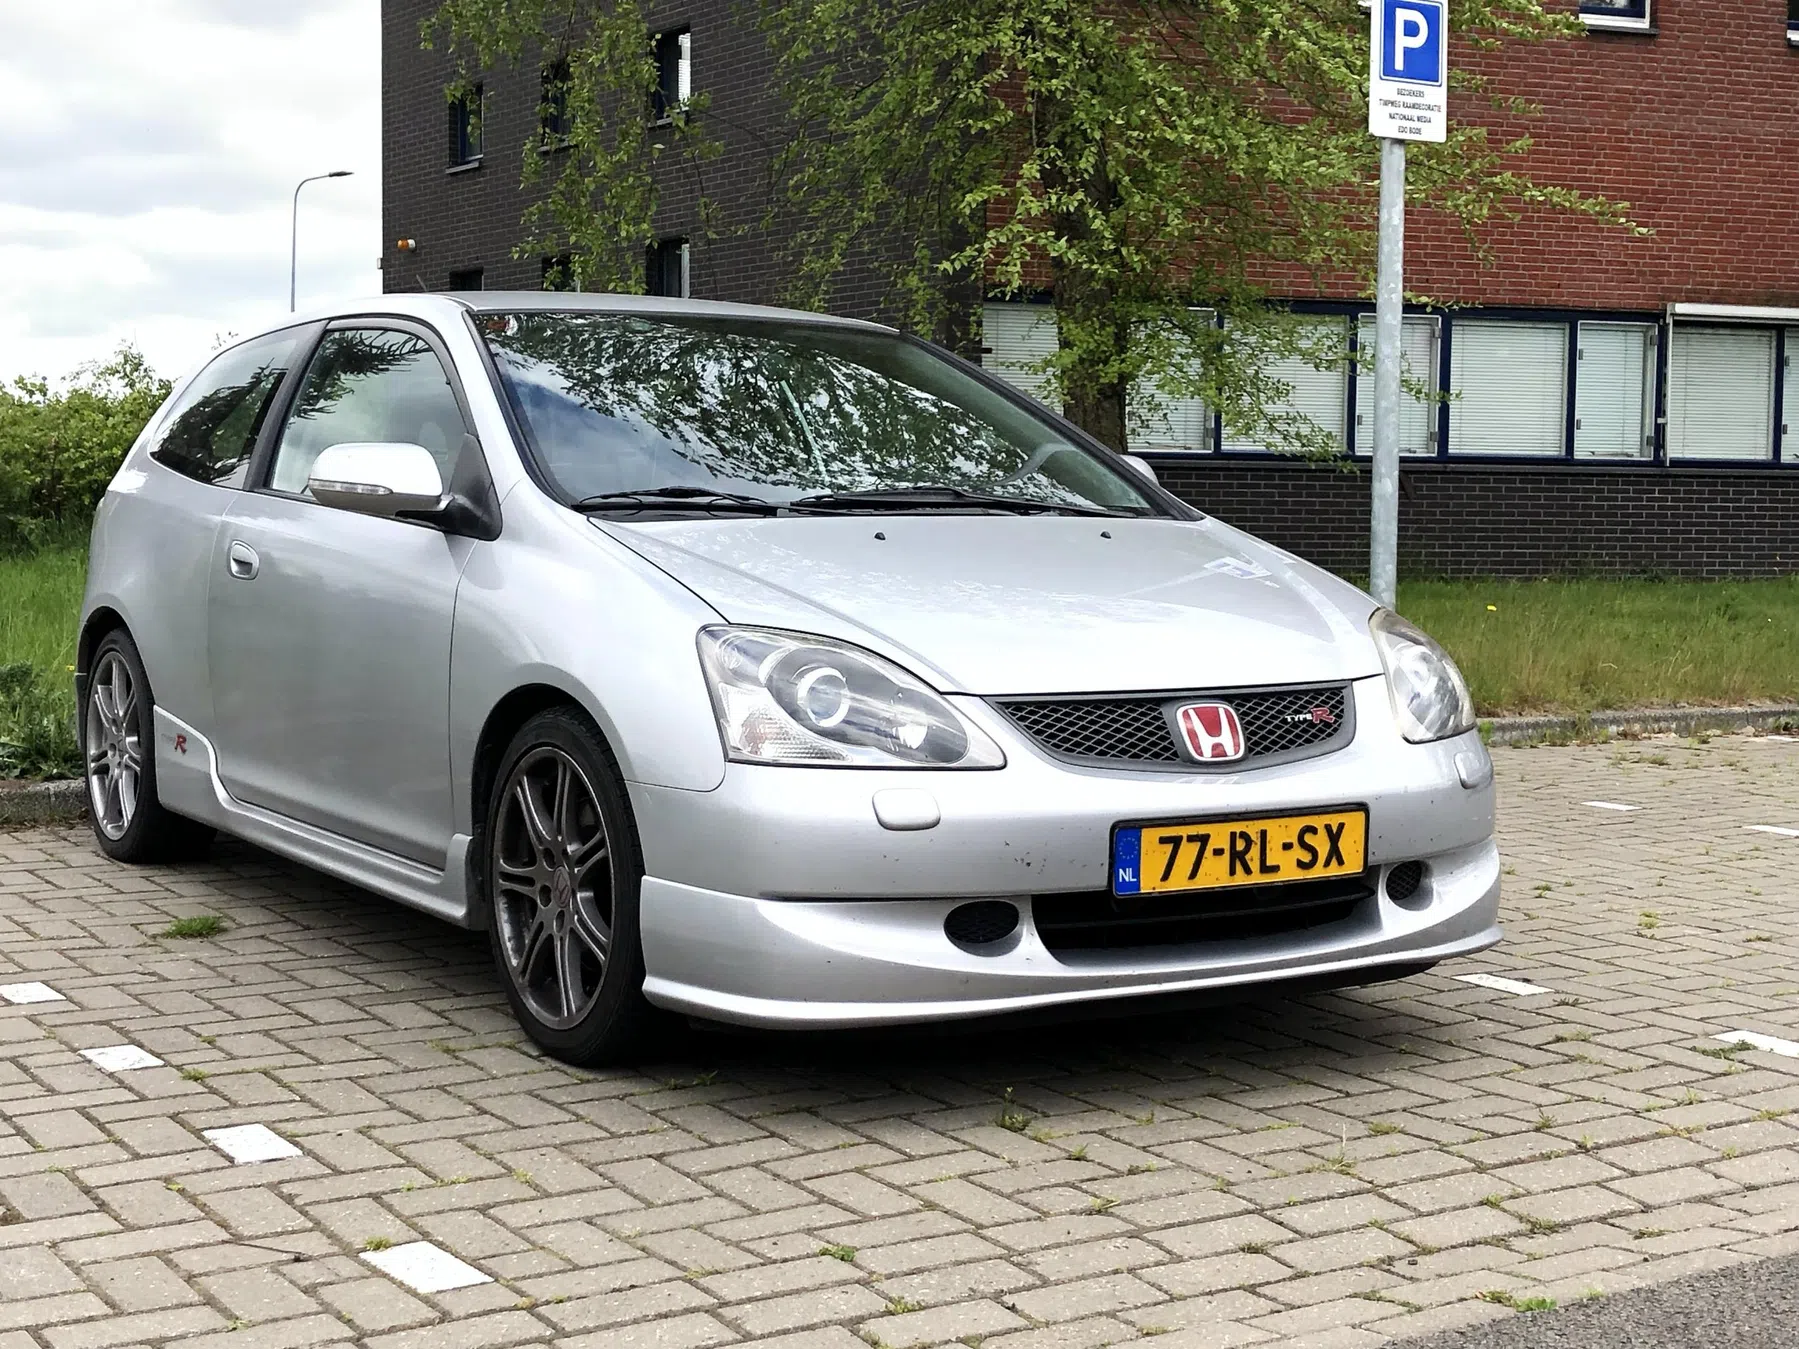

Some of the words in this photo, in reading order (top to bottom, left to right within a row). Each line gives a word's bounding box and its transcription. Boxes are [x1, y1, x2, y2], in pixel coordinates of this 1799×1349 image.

[1394, 7, 1429, 71] P
[1397, 88, 1425, 98] BEZOEKERS
[1402, 101, 1442, 113] RAAMDECORATIE
[1389, 112, 1415, 122] NATIONAAL
[1416, 115, 1432, 124] MEDIA
[1285, 713, 1312, 723] TYPE
[1311, 707, 1336, 724] R
[174, 733, 188, 755] R
[1158, 821, 1346, 882] 77-RL-SX
[1118, 867, 1137, 883] NL
